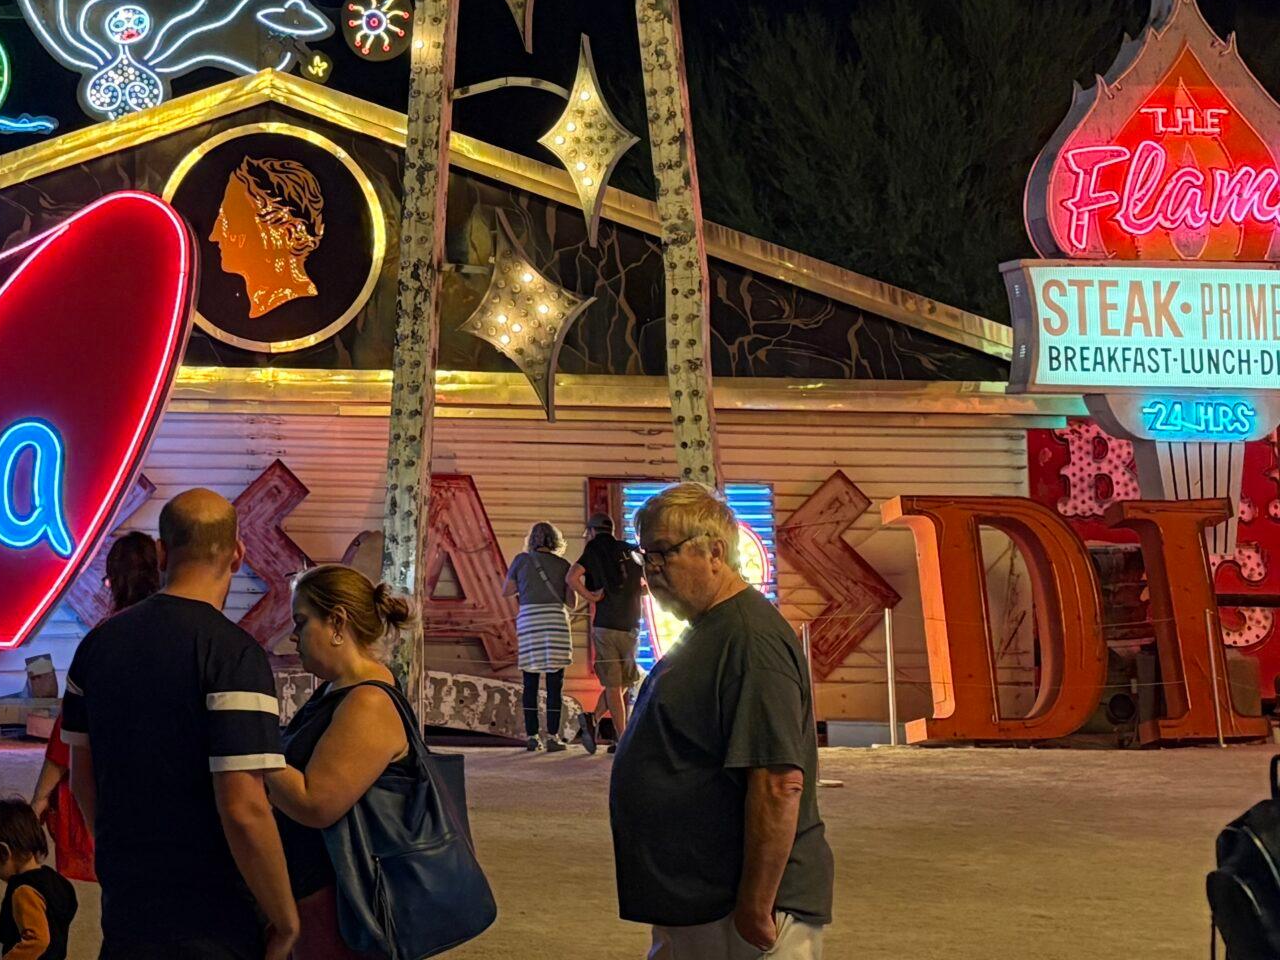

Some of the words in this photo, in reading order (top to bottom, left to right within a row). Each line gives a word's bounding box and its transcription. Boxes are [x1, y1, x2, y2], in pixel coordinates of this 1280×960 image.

[1140, 107, 1229, 134] THE
[1041, 278, 1184, 338] STEAK
[1142, 401, 1183, 431] 24
[1195, 401, 1255, 435] HRS
